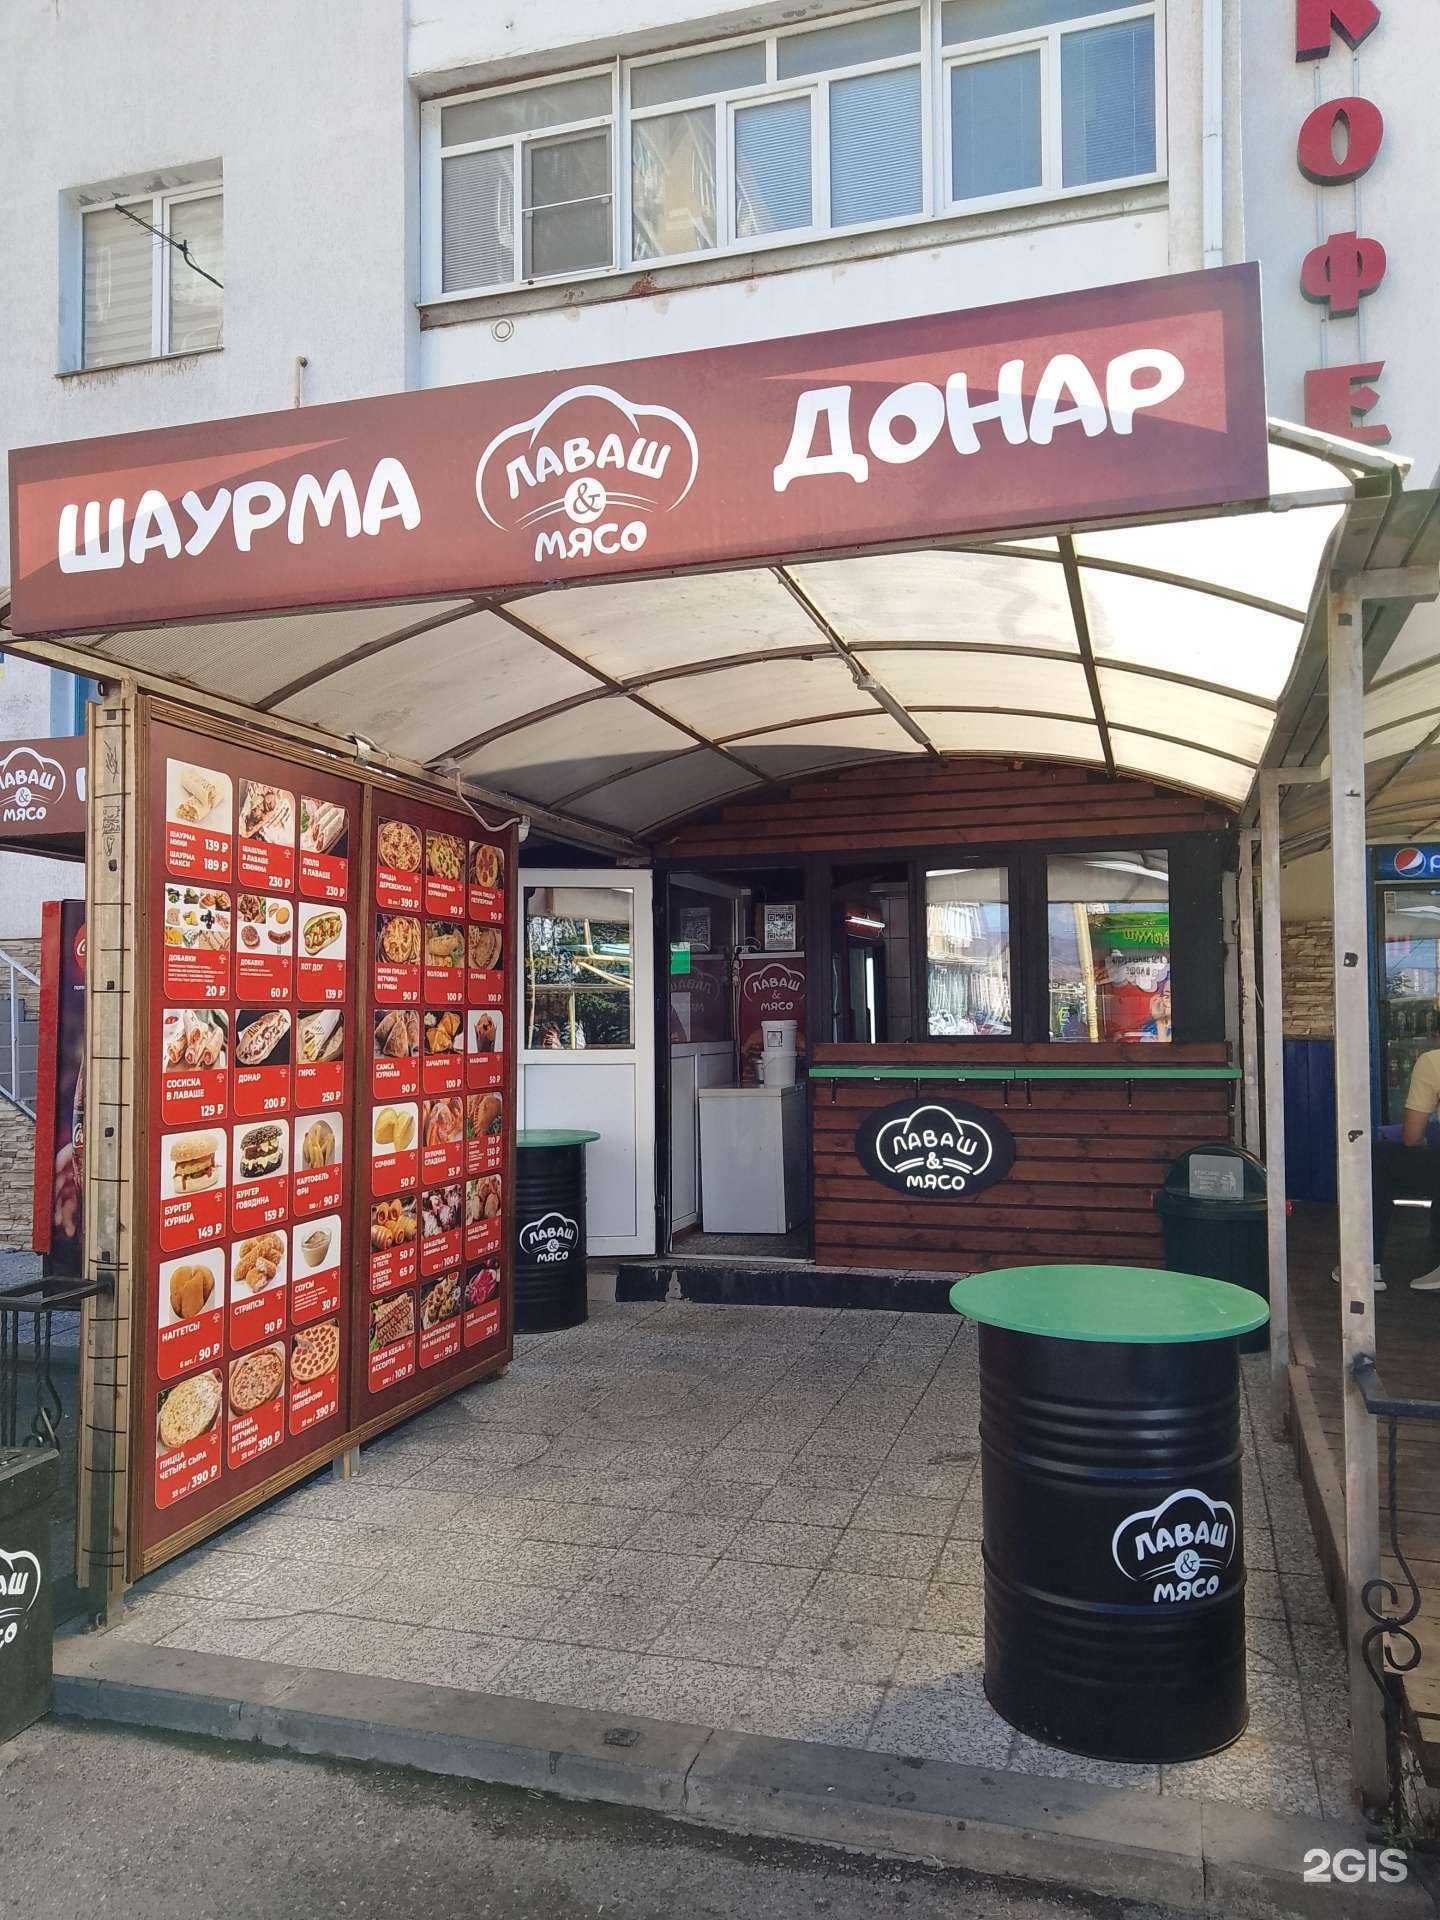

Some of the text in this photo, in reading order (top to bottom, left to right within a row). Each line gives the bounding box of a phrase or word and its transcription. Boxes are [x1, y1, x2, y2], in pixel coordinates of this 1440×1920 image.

[773, 348, 1184, 491] ДОНАР
[506, 433, 671, 499] ЛАВАШ
[58, 457, 421, 574] ШАУРМА
[534, 520, 647, 562] МЯСО
[3, 807, 46, 821] МЯСО
[170, 830, 196, 841] ШАУРМА
[204, 838, 220, 852] 139
[170, 850, 195, 861] ШАУРМА
[242, 854, 268, 864] В ЛАВАШЕ
[170, 858, 190, 868] МАКСИ
[204, 858, 219, 870] 189
[307, 869, 331, 880] ЛАВАШЕ
[268, 876, 283, 887] 230
[326, 886, 338, 896] 230
[400, 898, 413, 908] 390
[168, 954, 196, 962] ДОБАВКИ
[312, 963, 323, 972] ДОГ
[205, 985, 217, 996] 20
[752, 978, 800, 993] ЛАВАШ
[271, 987, 281, 997] 60
[325, 989, 336, 999] 139
[447, 993, 456, 1001] 100
[760, 1002, 794, 1011] МЯСО
[298, 1069, 316, 1077] ГИРОС
[376, 1064, 394, 1072] САМСА
[376, 1070, 400, 1078] КУРИНАЯ
[167, 1078, 201, 1088] СОСИСКА
[238, 1073, 261, 1084] ДОНАР
[446, 1080, 456, 1088] 100
[166, 1089, 205, 1100] В ЛАВАШЕ
[401, 1084, 410, 1093] 90
[321, 1092, 334, 1102] 250
[264, 1098, 278, 1110] 200
[200, 1105, 215, 1116] 129
[893, 1130, 978, 1155] ЛАВАШ
[926, 1152, 943, 1169] &
[447, 1168, 455, 1176] 35
[296, 1172, 329, 1186] КАРТОФЕЛЬ
[400, 1178, 409, 1188] 50
[906, 1174, 966, 1190] МЯСО
[236, 1187, 259, 1199] БУРГЕР
[296, 1187, 309, 1196] ФРИ
[236, 1196, 270, 1210] ГОВЯДИНА
[324, 1196, 332, 1206] 90
[164, 1202, 192, 1215] БУРГЕР
[164, 1214, 194, 1227] КУРИЦА
[264, 1210, 276, 1221] 159
[198, 1225, 213, 1239] 149
[529, 1227, 574, 1244] ЛАВАШ
[400, 1250, 408, 1260] 50
[536, 1251, 568, 1263] МЯСО
[400, 1268, 408, 1277] 65
[294, 1280, 314, 1293] СОУСЫ
[234, 1298, 265, 1316] СТРИПСЫ
[322, 1299, 330, 1311] 30
[162, 1321, 200, 1342] НАГГЕТСЫ
[264, 1323, 276, 1334] 90
[199, 1347, 210, 1360] 90
[372, 1358, 396, 1373] АССОРТИ
[395, 1366, 406, 1379] 100
[292, 1387, 311, 1402] ПИЦЦА
[292, 1390, 323, 1411] ПЕППЕРОНИ
[315, 1406, 329, 1420] 390
[232, 1417, 254, 1432] ПИЦЦА
[232, 1425, 258, 1443] ВЕТЧИНА
[231, 1435, 258, 1454] И ГРИБЫ
[257, 1438, 272, 1452] 390
[160, 1450, 185, 1470] ПИЦЦА
[160, 1450, 207, 1480] ЧЕТЫРЕ СЫРА
[191, 1471, 208, 1488] 390
[1135, 1521, 1228, 1560] ЛАВАШ
[1154, 1575, 1220, 1603] МЯСО
